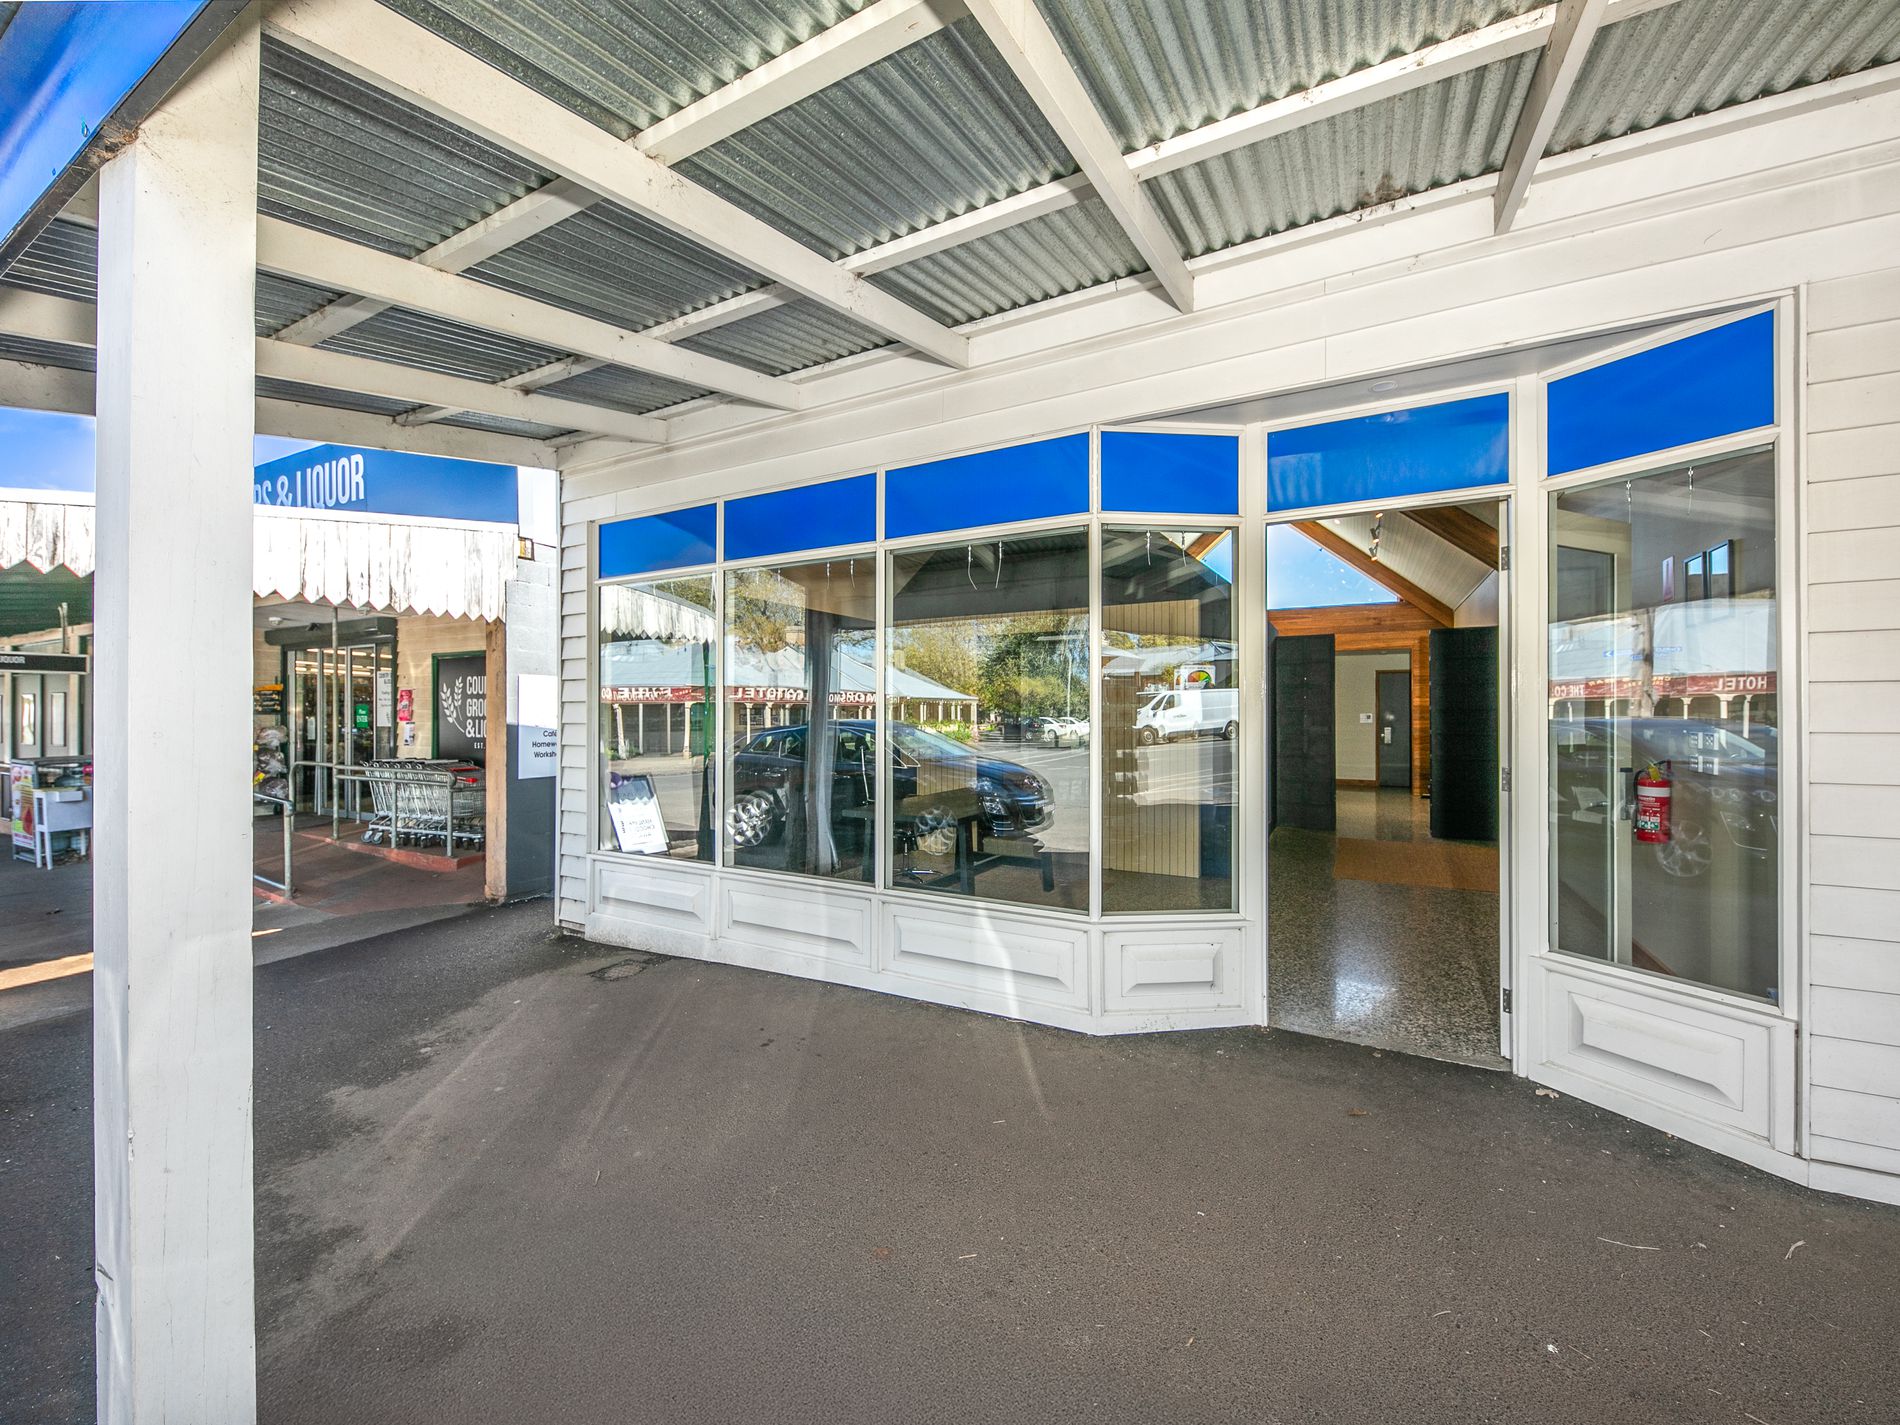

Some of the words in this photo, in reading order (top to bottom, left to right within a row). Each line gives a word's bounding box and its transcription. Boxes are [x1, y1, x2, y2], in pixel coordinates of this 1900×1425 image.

[276, 475, 293, 507] &
[296, 454, 364, 510] LIQUOR
[466, 675, 486, 695] COU
[466, 698, 486, 717] GRO
[533, 750, 557, 758] Worksh
